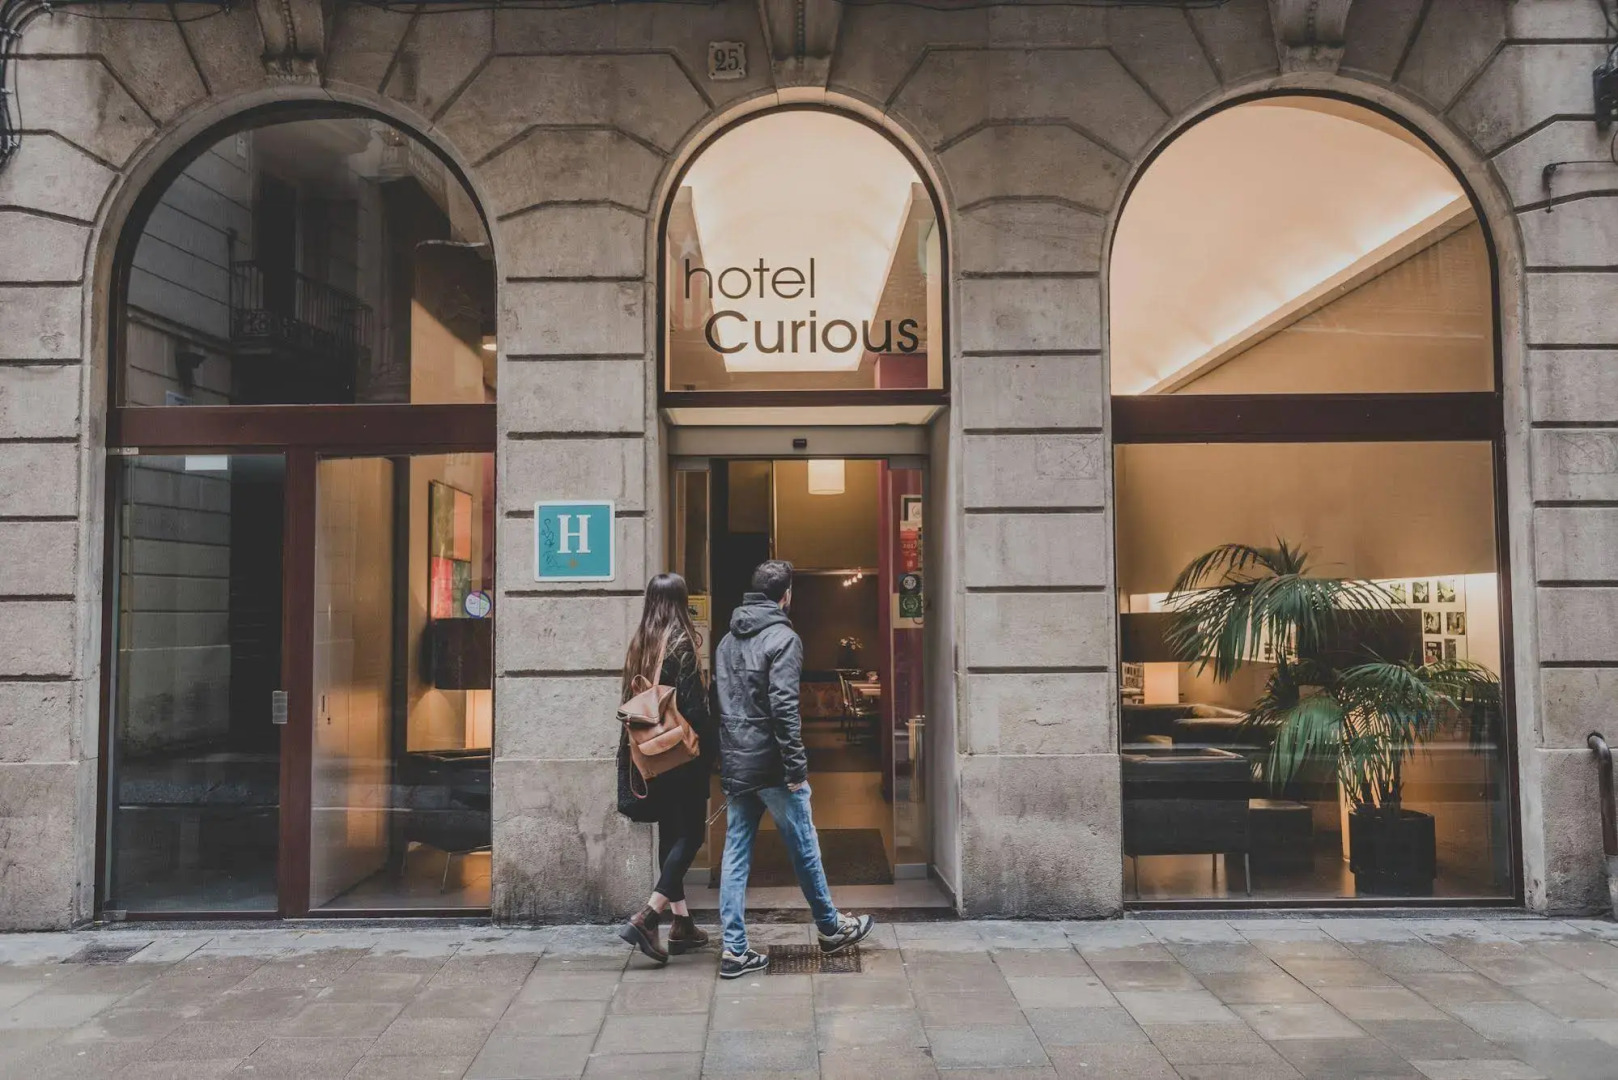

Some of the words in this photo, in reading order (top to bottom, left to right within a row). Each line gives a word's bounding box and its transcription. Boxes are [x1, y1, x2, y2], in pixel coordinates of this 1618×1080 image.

[714, 49, 739, 71] 25
[685, 258, 815, 299] hotel
[704, 310, 919, 354] Curious
[557, 514, 592, 554] H
